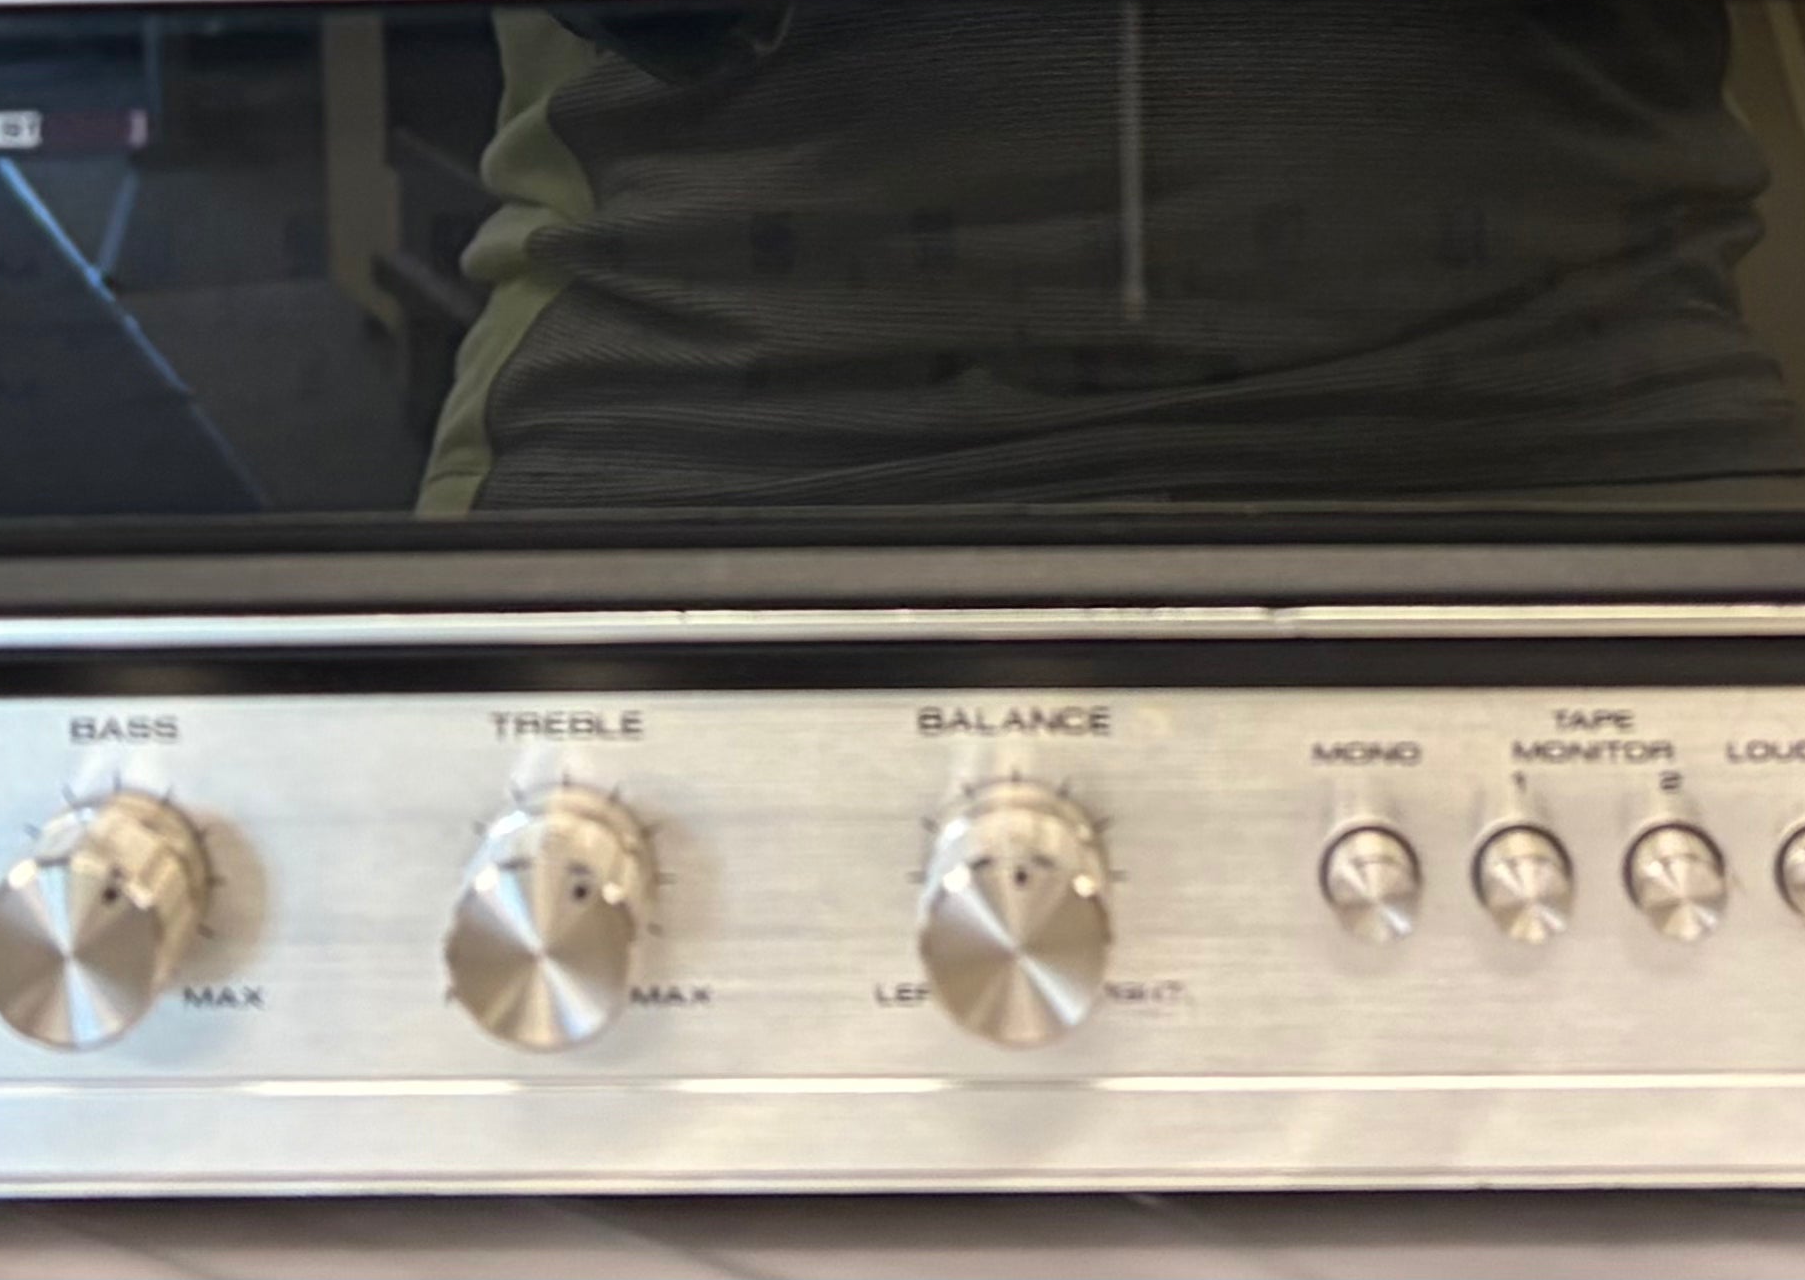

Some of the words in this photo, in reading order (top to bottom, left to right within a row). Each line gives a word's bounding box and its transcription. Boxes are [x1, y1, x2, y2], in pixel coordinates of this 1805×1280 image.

[68, 714, 180, 743] BASS
[491, 710, 645, 739] TREBLE
[917, 705, 1113, 735] BALANCE
[1552, 709, 1635, 732] TAPE
[1311, 740, 1422, 765] MONO
[1511, 739, 1675, 764] MONITOR
[182, 986, 264, 1009] MAX
[628, 986, 711, 1008] MAX
[874, 982, 931, 1007] LEF
